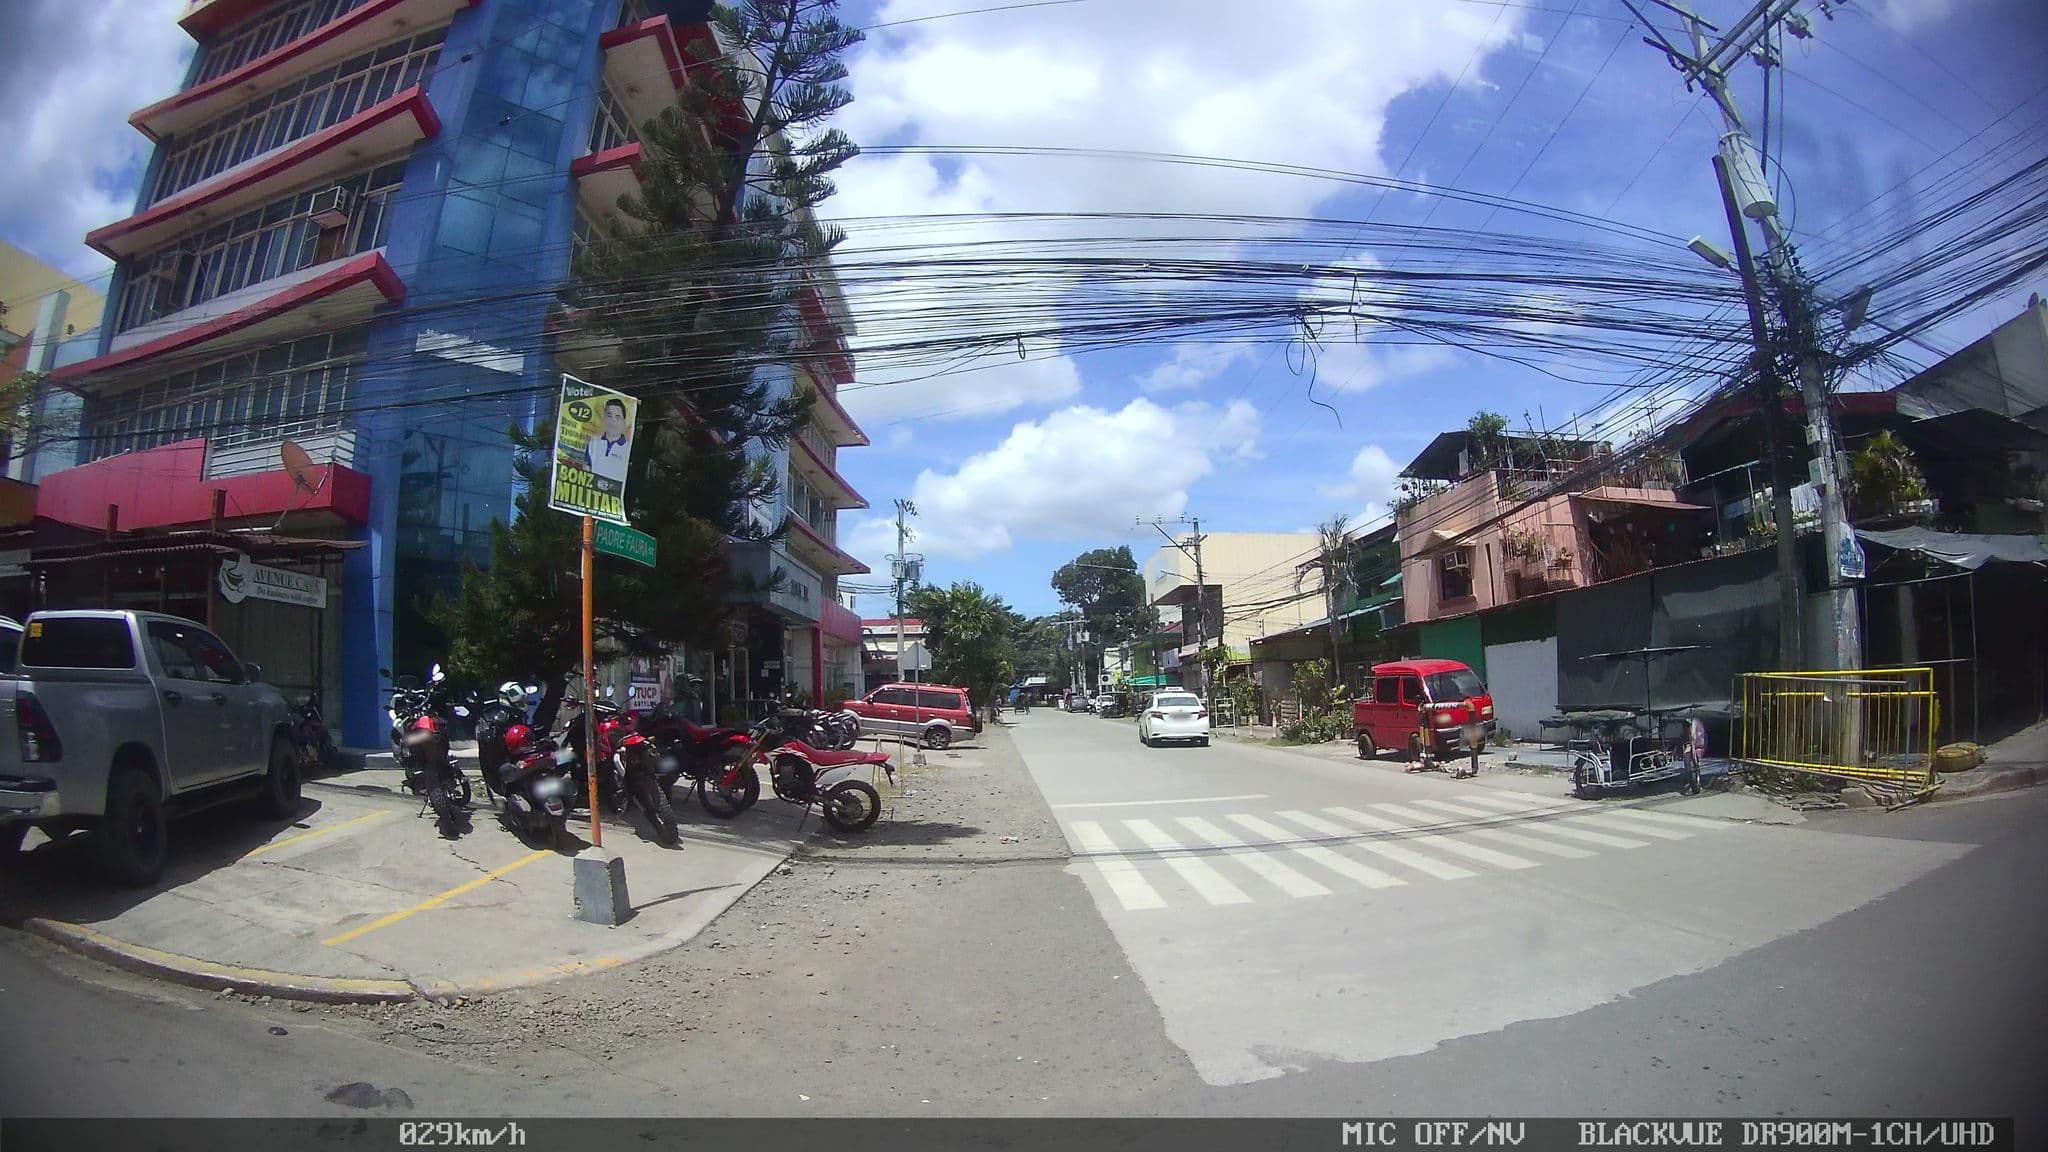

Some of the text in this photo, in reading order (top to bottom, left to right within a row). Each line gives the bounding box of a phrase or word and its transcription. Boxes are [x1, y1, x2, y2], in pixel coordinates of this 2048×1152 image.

[559, 465, 595, 488] BONZ
[555, 482, 622, 515] MILITAR
[596, 526, 625, 549] PADRE
[626, 535, 648, 557] FAURA
[253, 568, 294, 587] AVENUE
